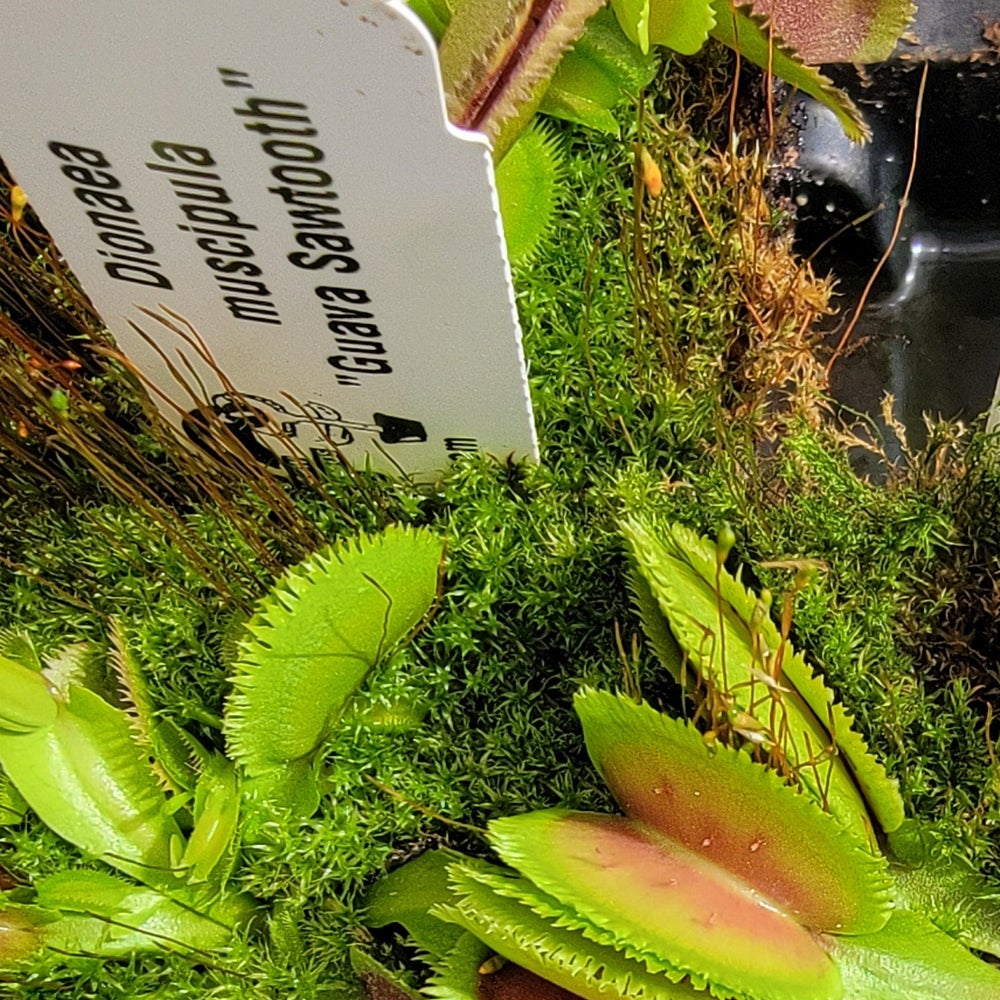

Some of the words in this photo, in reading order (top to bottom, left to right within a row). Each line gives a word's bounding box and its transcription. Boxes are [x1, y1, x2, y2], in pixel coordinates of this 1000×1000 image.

[48, 140, 174, 291] Dionaea
[145, 140, 282, 325] muscipula
[217, 66, 361, 274] Sawtooth"
[315, 285, 393, 387] "Guava
